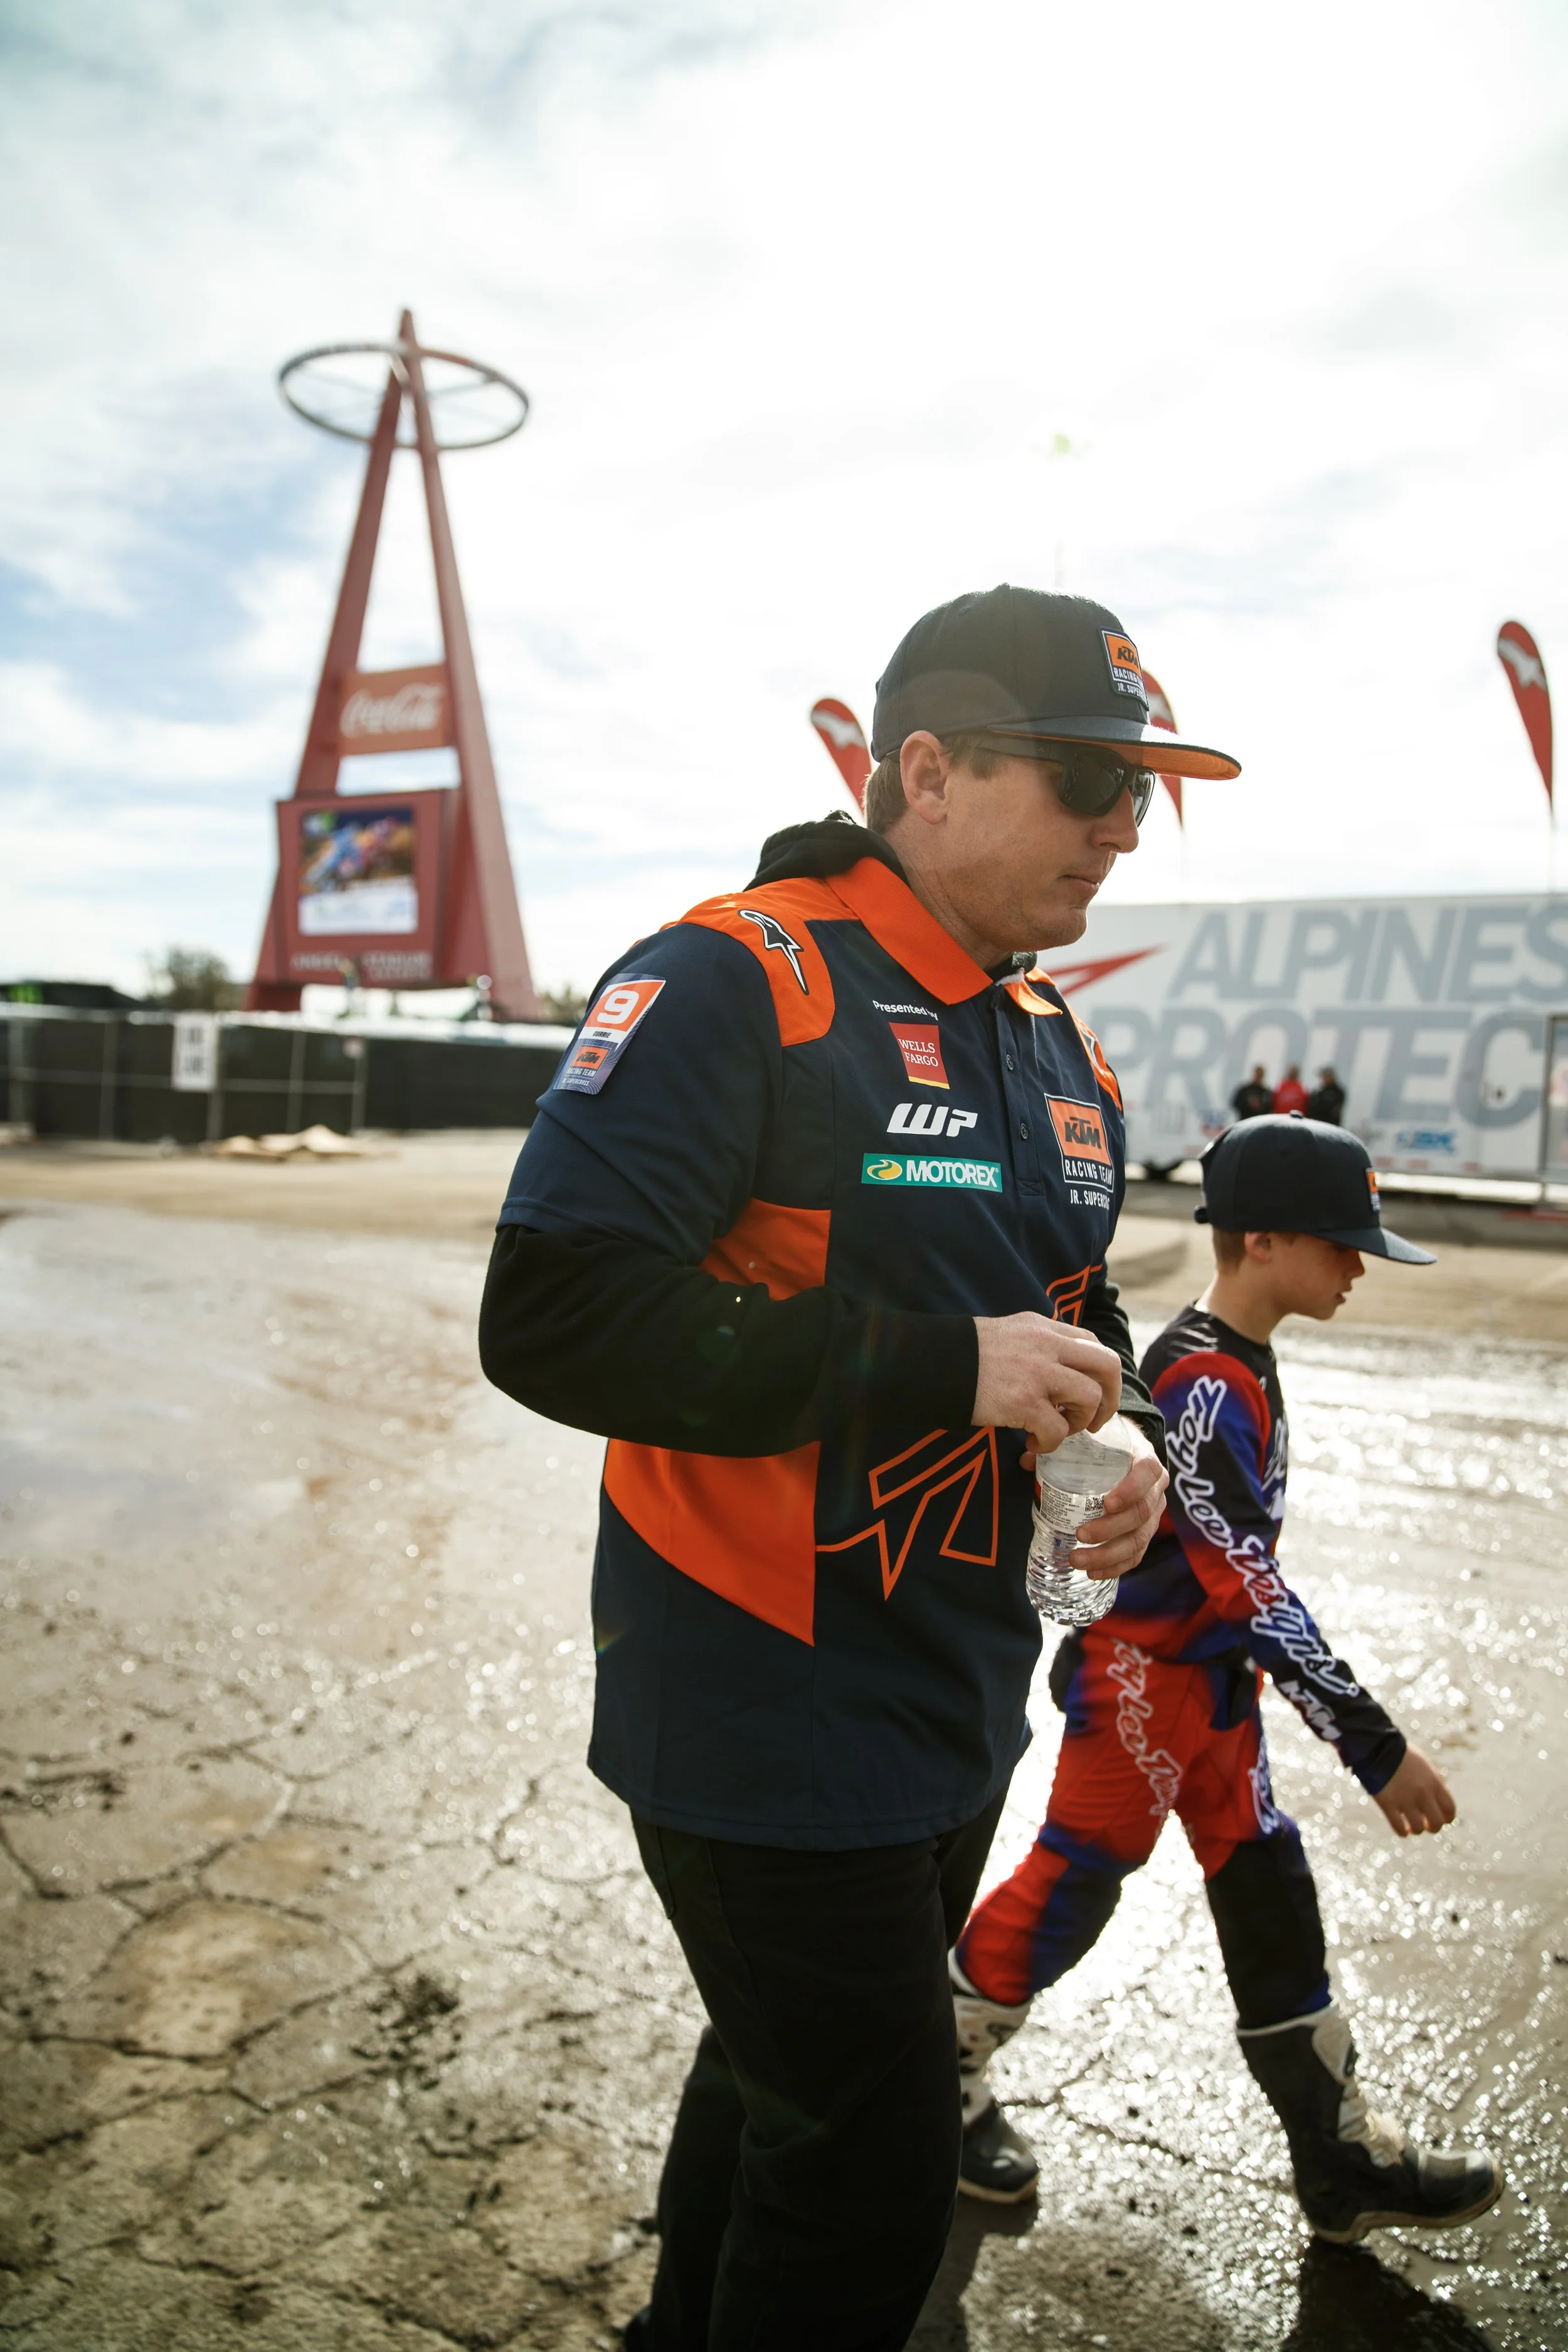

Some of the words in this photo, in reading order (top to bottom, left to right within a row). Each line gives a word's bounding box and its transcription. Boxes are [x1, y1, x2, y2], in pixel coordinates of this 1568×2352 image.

[1117, 645, 1138, 669] KTM
[1113, 667, 1137, 683] RACING
[1165, 904, 1568, 1004] ALPINES
[596, 990, 640, 1024] 9
[872, 1000, 928, 1015] Presented
[898, 1038, 936, 1054] WELLS
[576, 1051, 601, 1064] KTM
[904, 1051, 939, 1067] FARGO
[1089, 1006, 1546, 1128] PROTEC
[566, 1067, 583, 1076] RACING
[582, 1069, 596, 1078] TEAM
[886, 1103, 978, 1137] WP
[1064, 1116, 1102, 1150] KTM
[1064, 1159, 1098, 1180] RACING
[1098, 1165, 1113, 1185] TEAM
[1070, 1189, 1082, 1205] JR.
